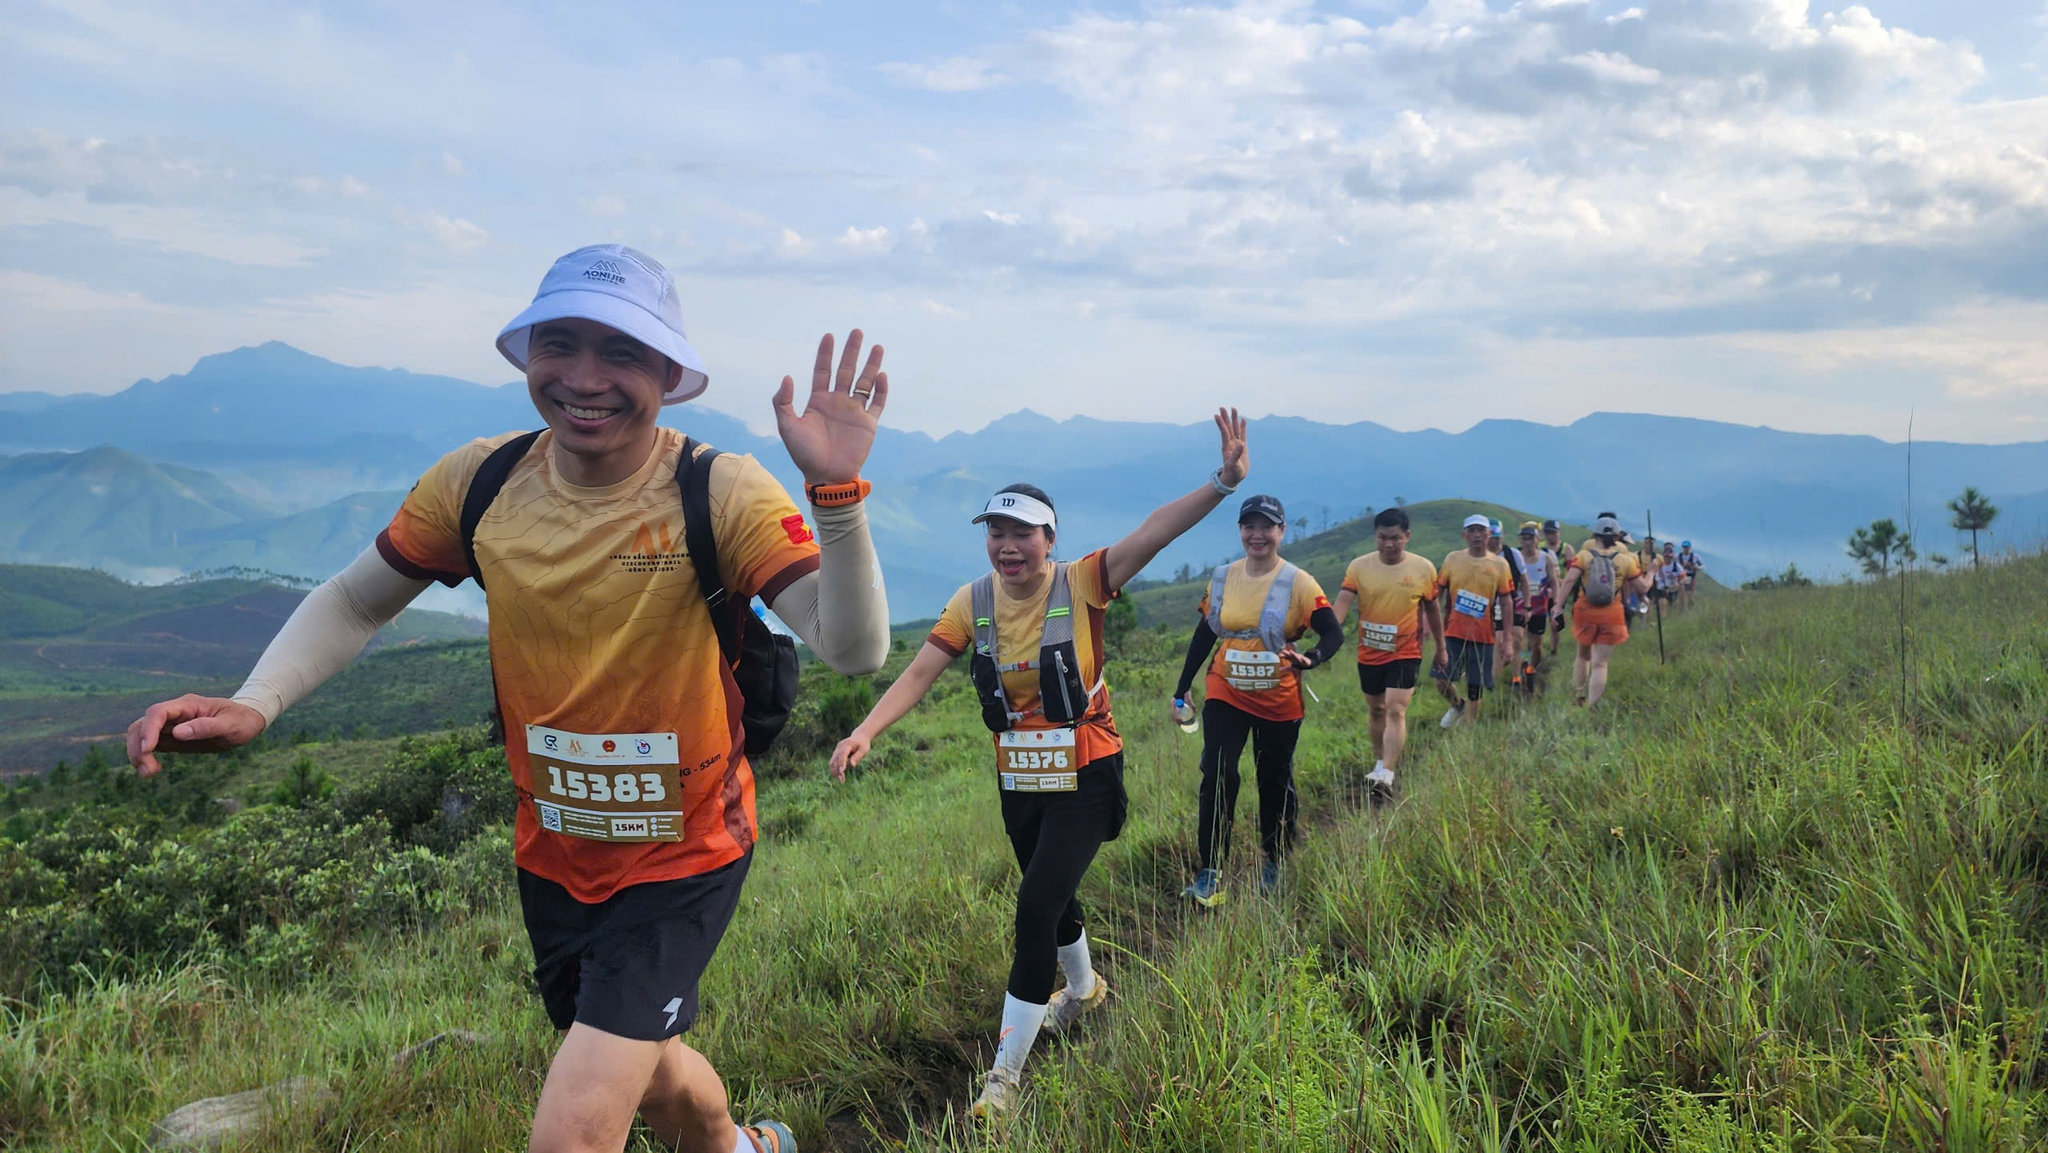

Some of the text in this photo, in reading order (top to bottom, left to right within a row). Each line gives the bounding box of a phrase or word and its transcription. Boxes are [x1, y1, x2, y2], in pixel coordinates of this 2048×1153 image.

[1365, 630, 1393, 642] 15247
[1231, 664, 1275, 677] 15387
[1008, 751, 1068, 769] 15376
[548, 766, 667, 803] 15383
[615, 823, 644, 832] 15KM
